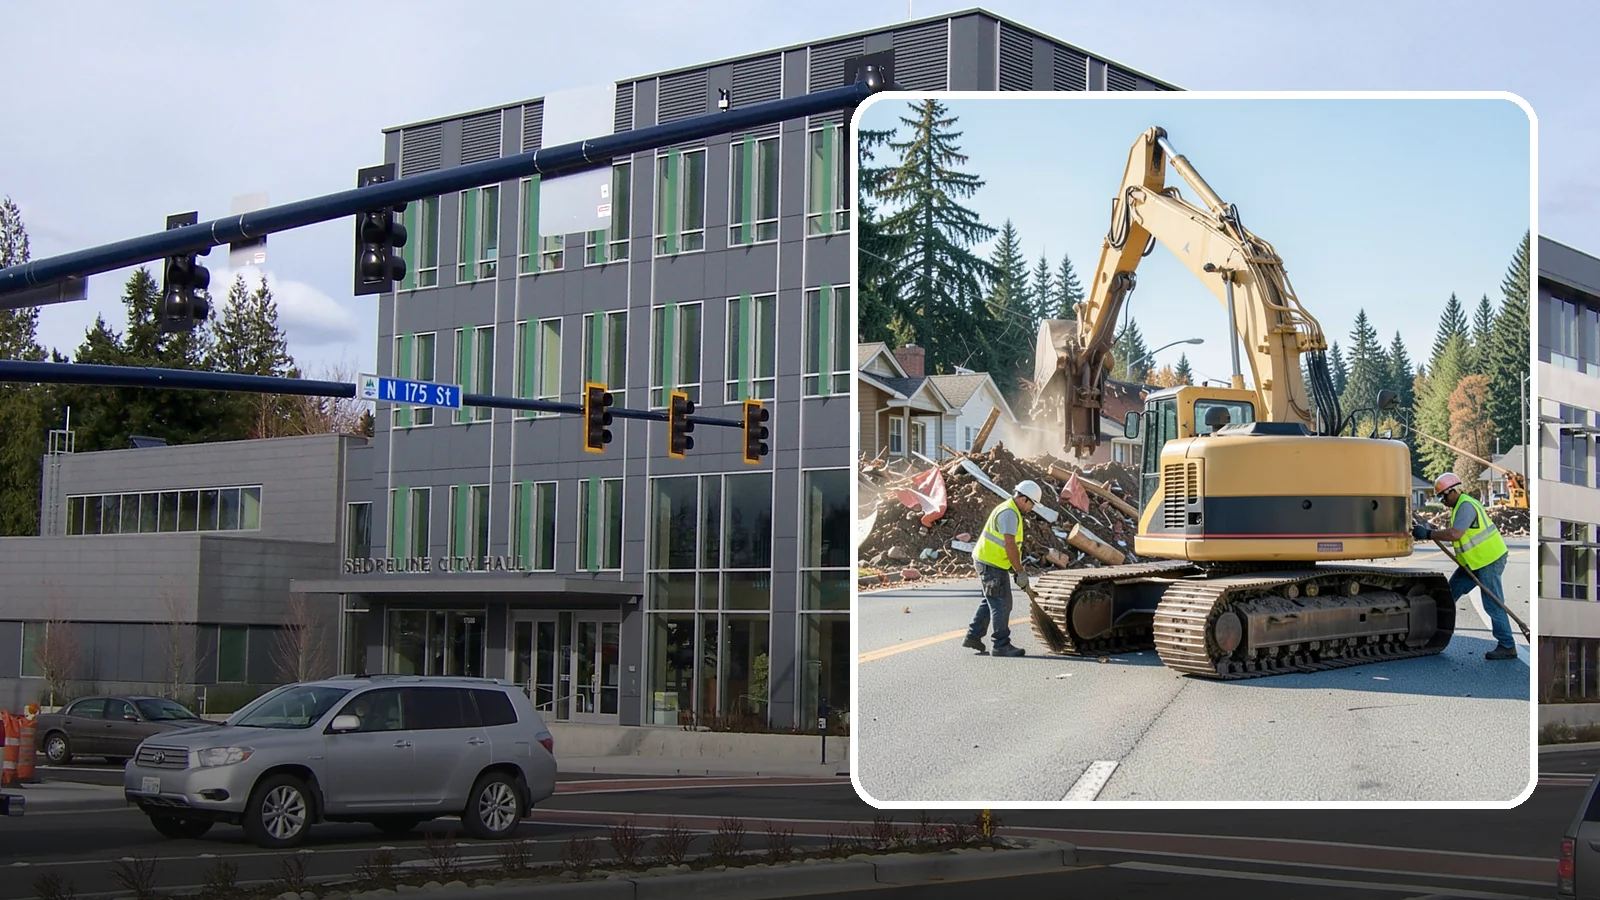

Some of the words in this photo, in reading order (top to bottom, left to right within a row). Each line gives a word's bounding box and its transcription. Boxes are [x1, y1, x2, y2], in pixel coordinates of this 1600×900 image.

[387, 381, 396, 400] N
[405, 383, 427, 403] 175
[436, 386, 451, 406] St
[343, 557, 432, 574] SHORELINE
[438, 556, 476, 572] CITY
[484, 555, 525, 571] HALL
